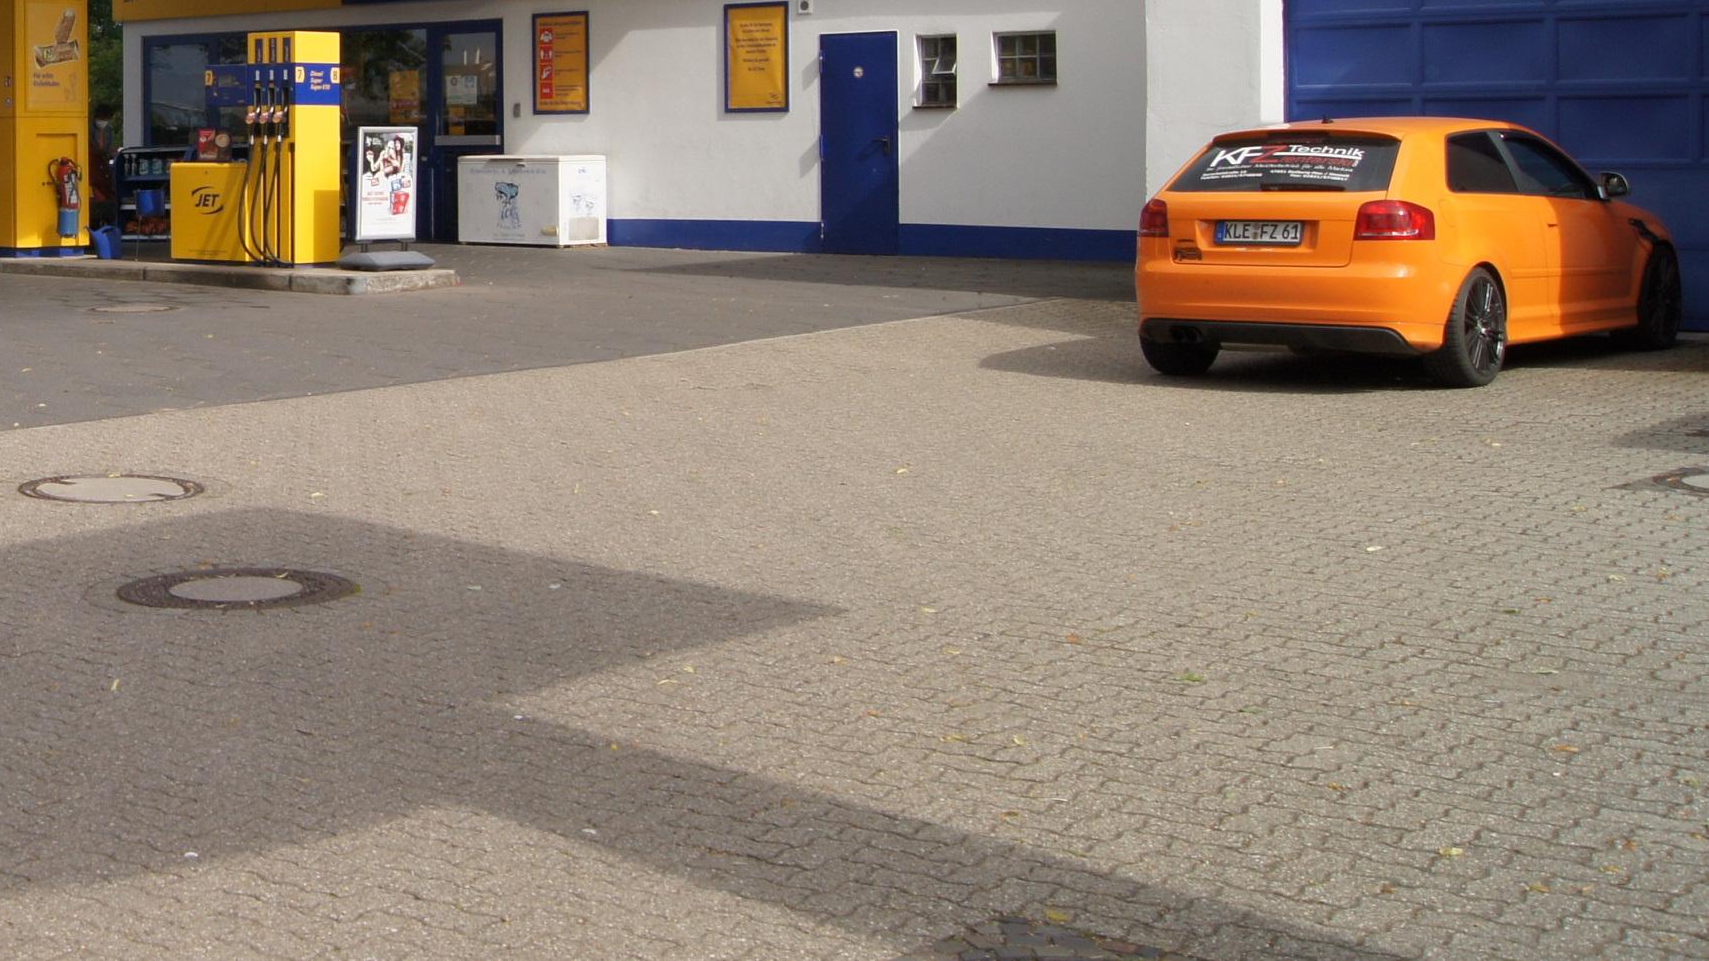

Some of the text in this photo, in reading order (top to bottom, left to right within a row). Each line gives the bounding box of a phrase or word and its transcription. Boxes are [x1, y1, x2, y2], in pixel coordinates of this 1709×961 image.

[1210, 144, 1365, 167] KFZ Technik
[195, 193, 219, 208] JET
[1224, 223, 1299, 240] KLE FZ 61
